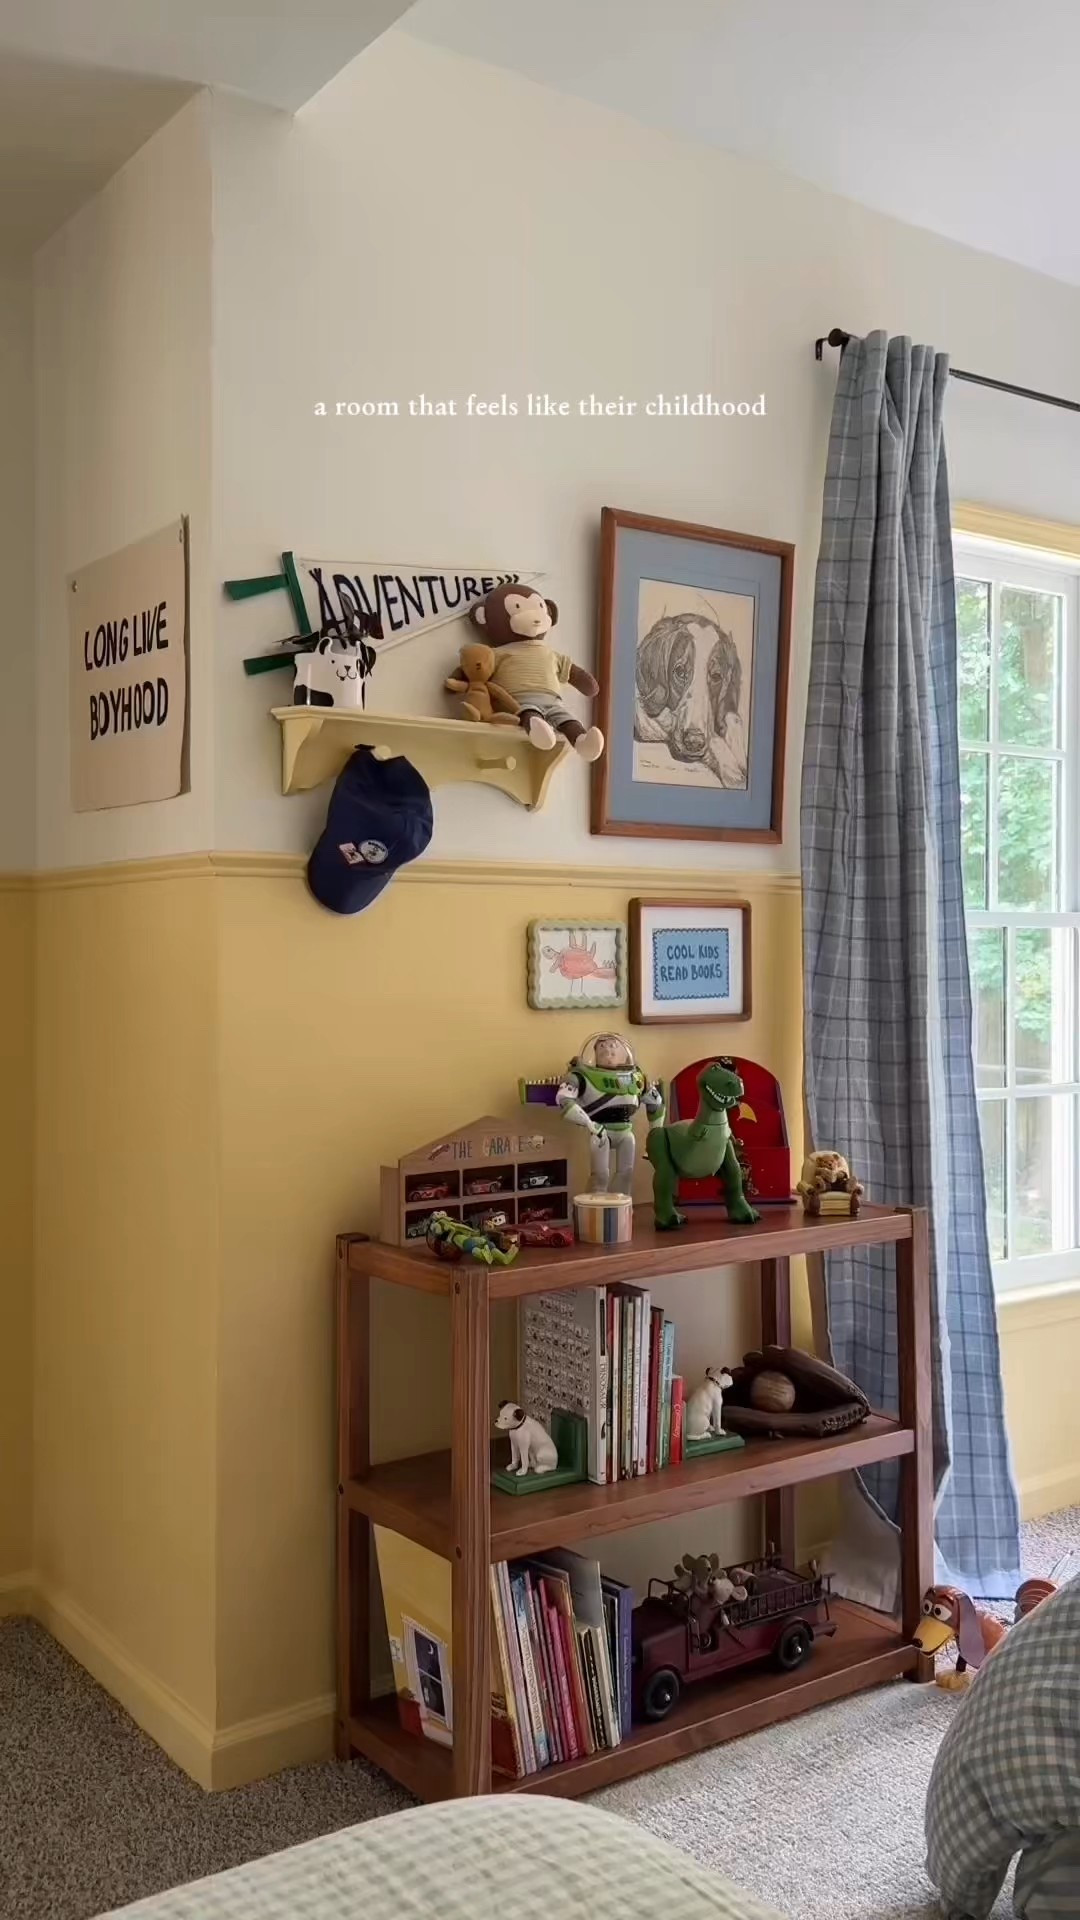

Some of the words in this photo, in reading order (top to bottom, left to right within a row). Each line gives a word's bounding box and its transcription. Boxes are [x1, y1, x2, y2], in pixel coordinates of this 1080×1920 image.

[309, 567, 494, 649] ADVENTURE
[84, 617, 129, 671] LONG
[133, 601, 169, 657] LIVE
[90, 677, 169, 741] BOYHOOD
[660, 965, 688, 982] READ
[690, 963, 723, 980] BOOKS
[666, 944, 695, 960] COOL
[698, 944, 720, 960] KIDS
[452, 1140, 473, 1160] THE
